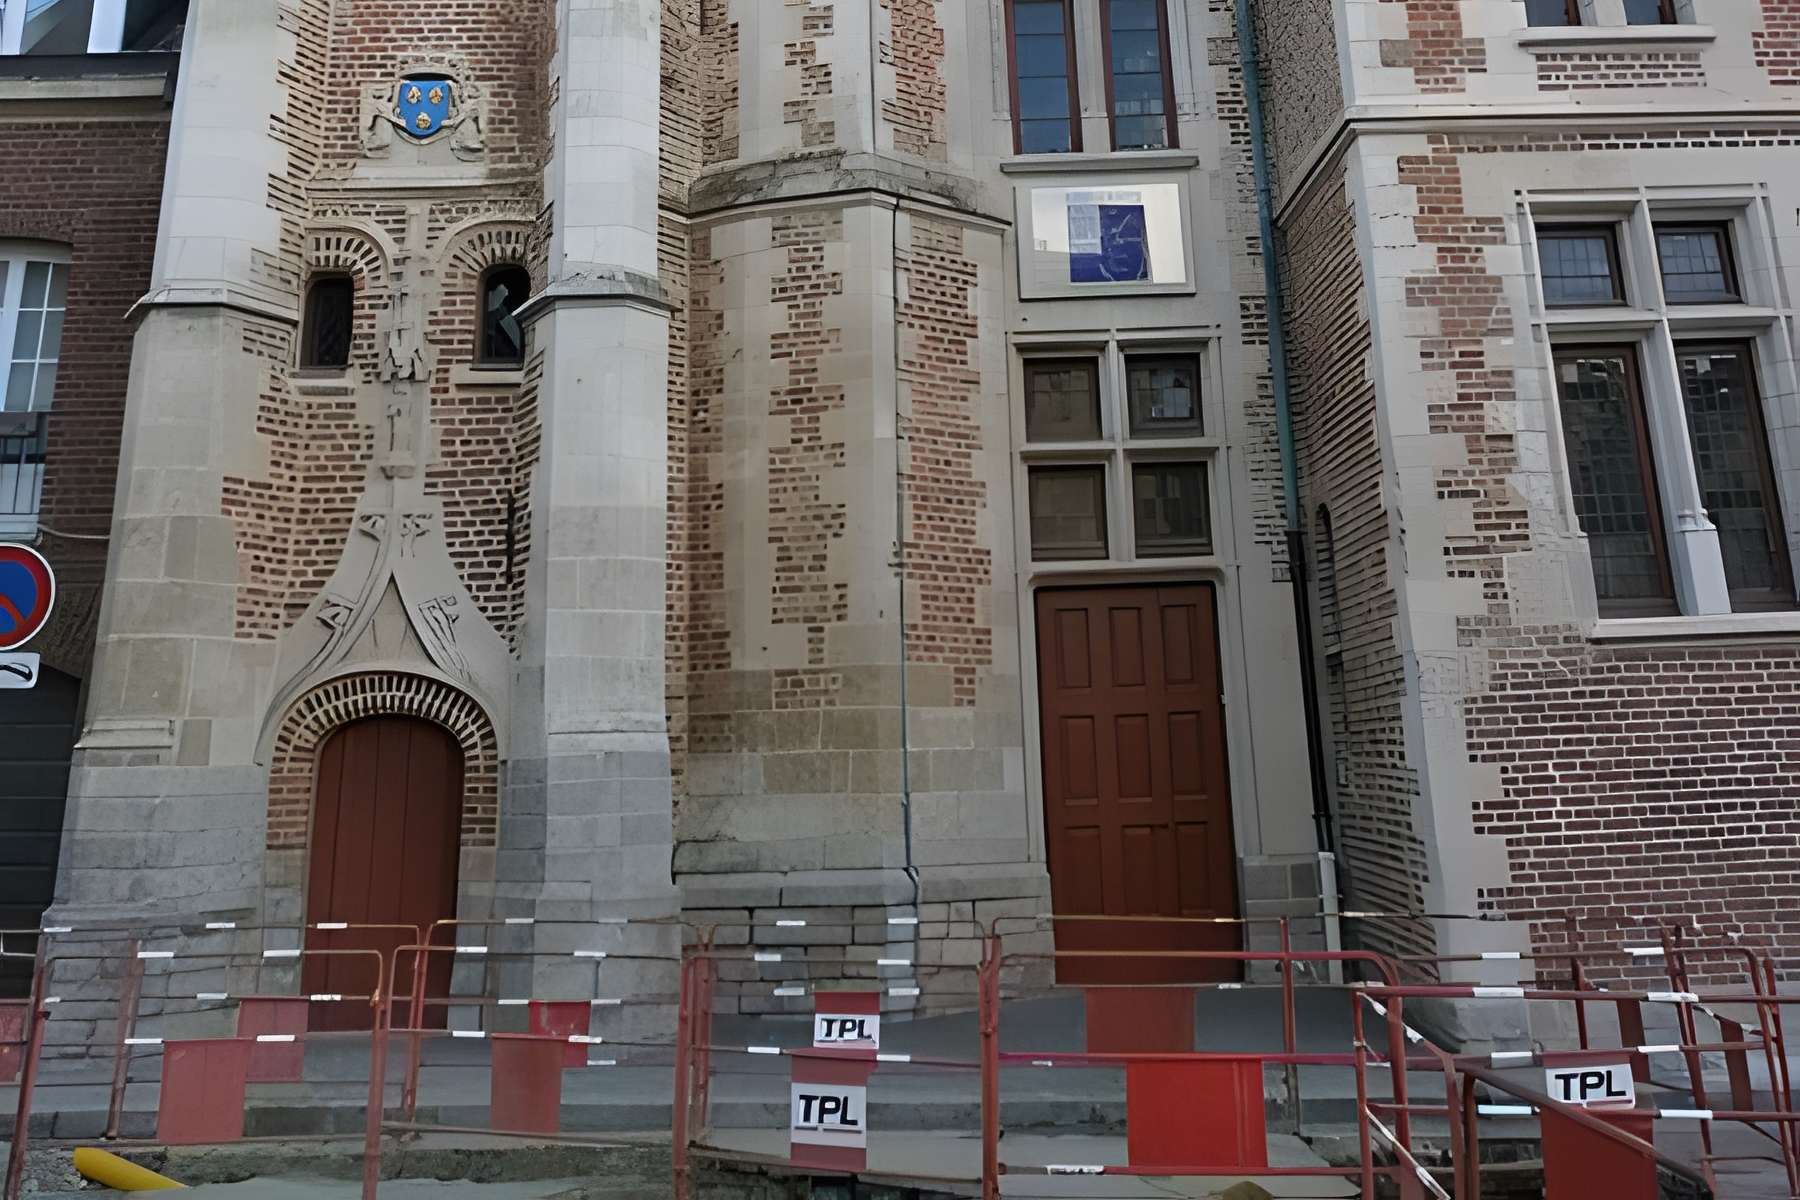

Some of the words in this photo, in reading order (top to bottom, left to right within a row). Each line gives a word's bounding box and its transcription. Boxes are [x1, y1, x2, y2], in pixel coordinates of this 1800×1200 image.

[821, 1018, 873, 1039] TPL
[1555, 1070, 1627, 1101] TPL
[799, 1094, 858, 1126] TPL
